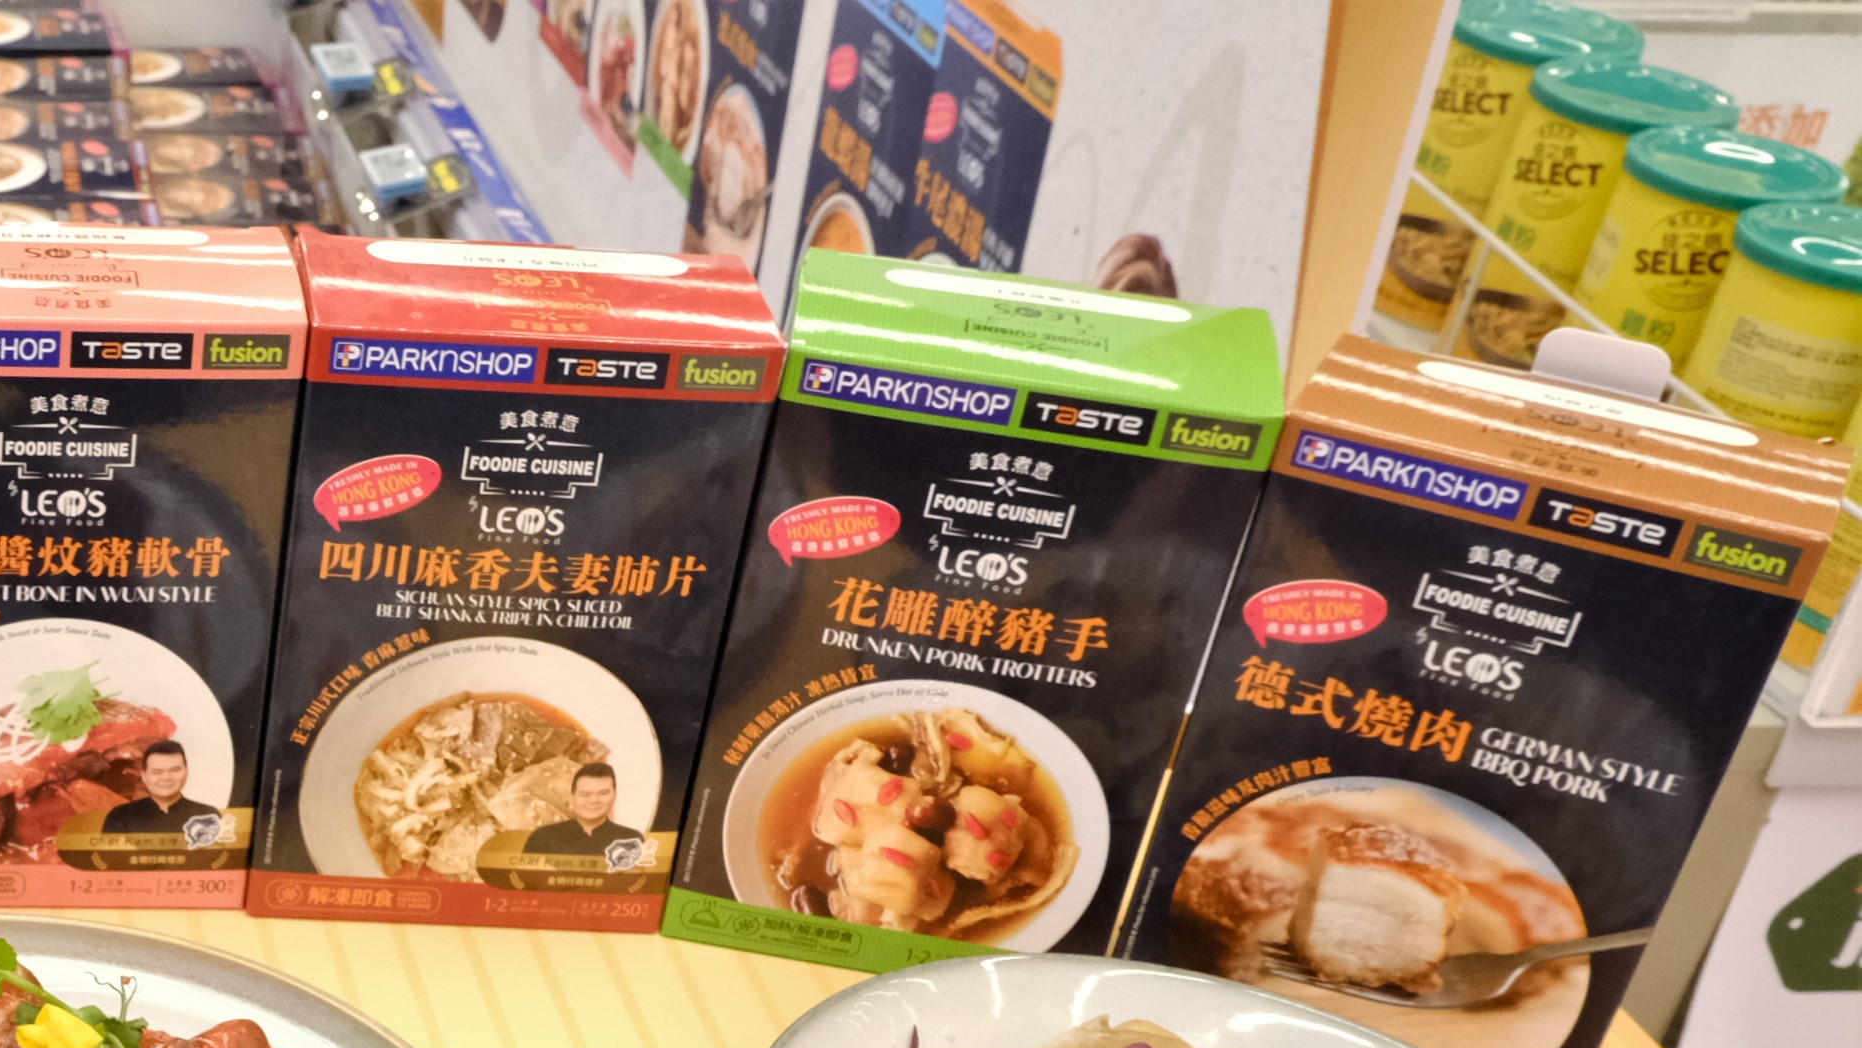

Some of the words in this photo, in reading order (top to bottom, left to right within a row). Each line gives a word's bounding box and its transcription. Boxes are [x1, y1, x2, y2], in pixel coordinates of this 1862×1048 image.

[1515, 158, 1604, 187] SELECT
[1635, 250, 1730, 276] SELEC
[210, 339, 283, 364] fusion
[684, 361, 757, 385] fusion
[30, 393, 110, 416] 美食煮意
[500, 410, 580, 433] 美食煮意
[1171, 418, 1250, 453] fusion
[5, 440, 62, 457] FOODIE
[66, 441, 129, 458] CUISINE
[328, 469, 370, 491] FRESHLY
[373, 463, 403, 475] MADE
[406, 460, 418, 469] IN
[470, 456, 527, 473] FOODIE
[531, 458, 594, 476] CUISINE
[331, 482, 376, 505] HONG
[378, 471, 421, 494] KONG
[784, 507, 828, 525] FRESHLY
[831, 505, 862, 514] MADE
[865, 504, 877, 513] IN
[934, 493, 995, 517] FOODIE
[997, 502, 1064, 527] CUISINE
[787, 521, 831, 540] HONG
[835, 516, 879, 535] KONG
[1696, 531, 1786, 577] fusion
[319, 540, 707, 597] 四川麻香夫妻肺片
[16, 584, 71, 602] BONE
[75, 586, 96, 602] IN
[99, 586, 153, 603] WUXI
[158, 586, 217, 602] STYLE
[395, 589, 463, 607] SICHUAN
[467, 593, 515, 609] STYLE
[518, 595, 564, 612] SPICY
[567, 598, 622, 614] SLICED
[376, 603, 413, 619] BEEF
[415, 606, 472, 623] SHANK
[474, 609, 485, 622] &
[490, 610, 534, 625] TRIPE
[537, 611, 554, 626] IN
[607, 614, 633, 629] OIL
[828, 576, 1109, 662] 花雕醉豬手
[1263, 605, 1313, 622] HONG
[1315, 602, 1363, 620] KONG
[1425, 584, 1491, 616] FOODIE
[1493, 602, 1569, 636] CUISINE
[822, 628, 924, 663] DRUNKEN
[925, 647, 984, 674] PORK
[990, 657, 1098, 689] TROTTERS
[1234, 656, 1472, 763] 德式燒肉
[1480, 726, 1597, 772] GERMAN
[1599, 758, 1685, 796] STYLE
[1470, 748, 1529, 789] BBQ
[1531, 767, 1609, 803] PORK
[70, 881, 92, 892] 1-2
[197, 880, 226, 893] 300
[610, 903, 641, 917] 250
